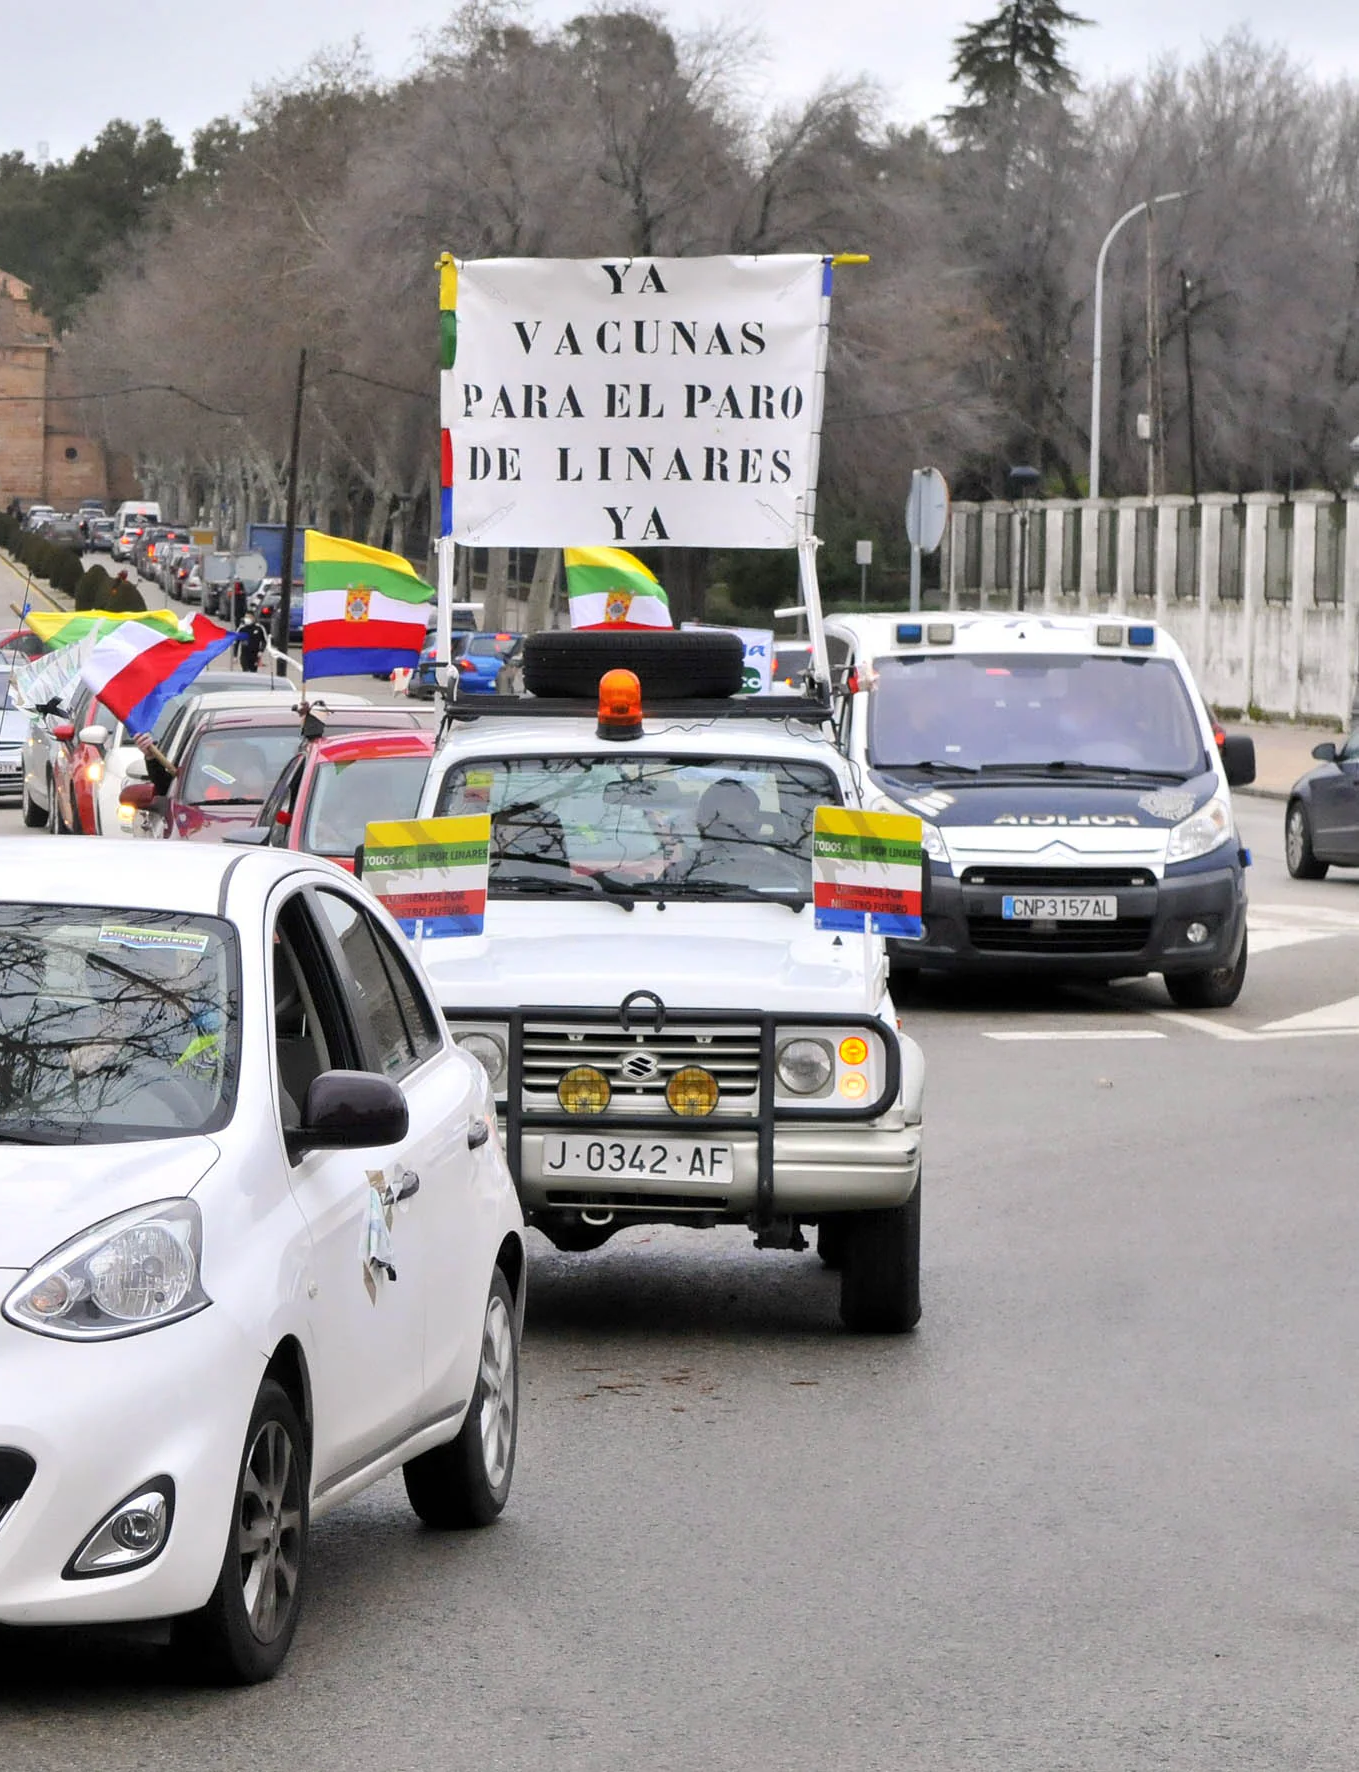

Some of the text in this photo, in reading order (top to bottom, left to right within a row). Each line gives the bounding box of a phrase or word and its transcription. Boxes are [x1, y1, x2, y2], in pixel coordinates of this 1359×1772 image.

[601, 263, 669, 295] YA
[512, 319, 767, 357] VACUNAS
[462, 383, 804, 420] PARA EL PARO
[468, 446, 793, 484] DE LINARES
[602, 506, 671, 541] YA
[363, 854, 396, 866] TODOS
[450, 848, 488, 861] LINARES
[814, 839, 842, 852] TODOS
[889, 847, 922, 859] LINARES
